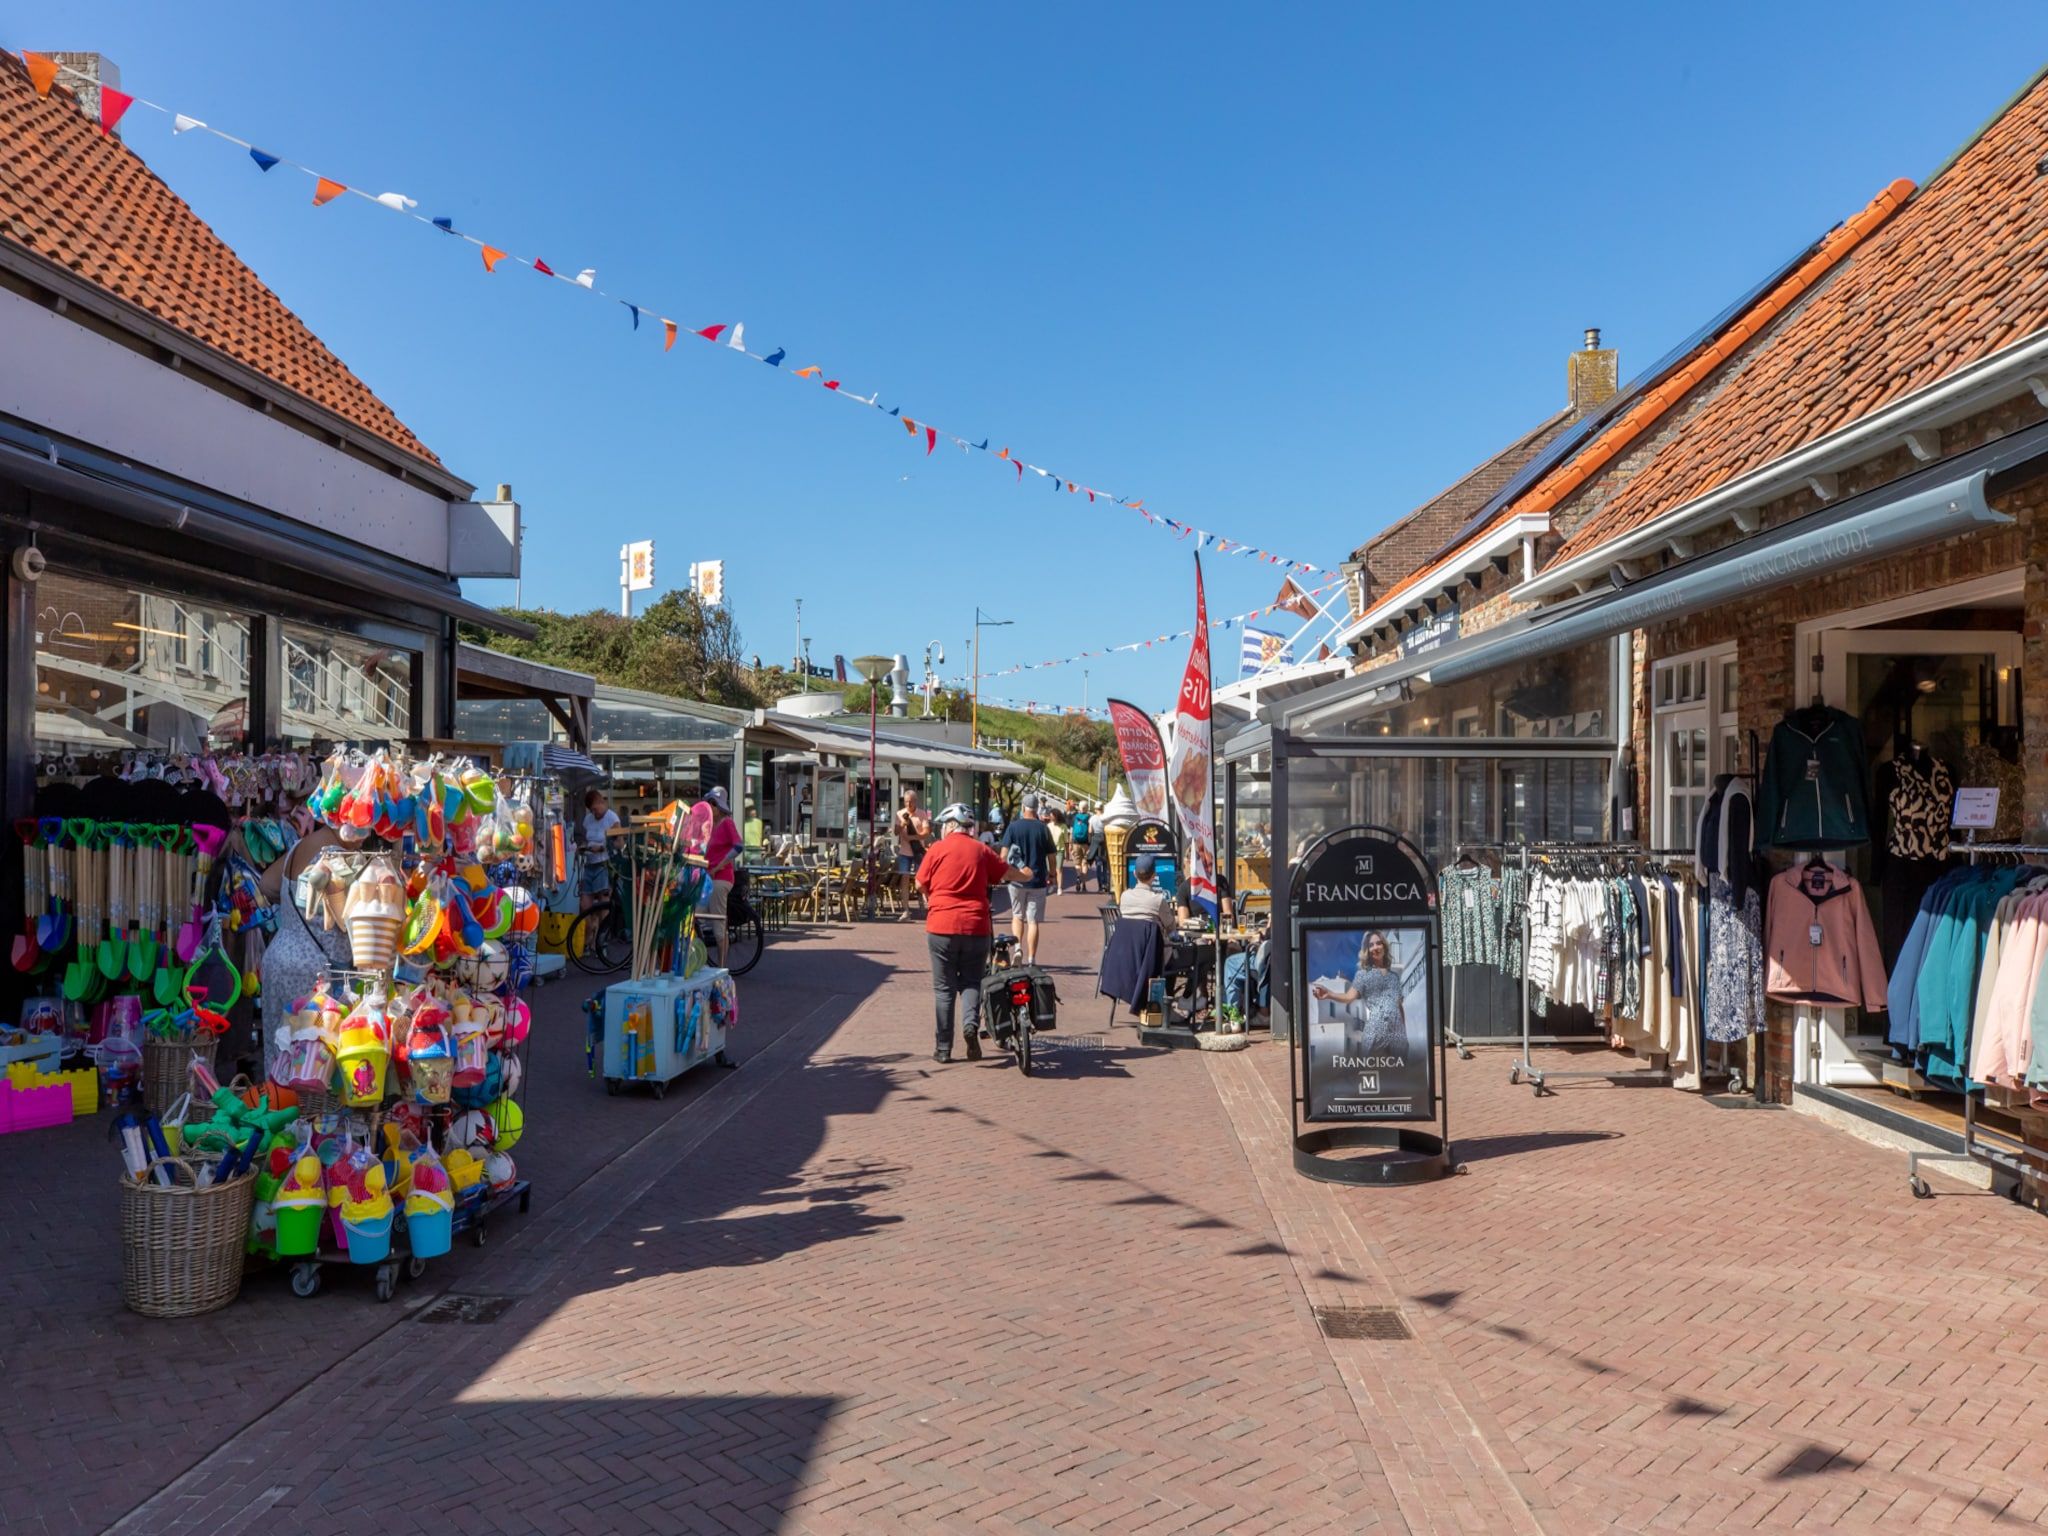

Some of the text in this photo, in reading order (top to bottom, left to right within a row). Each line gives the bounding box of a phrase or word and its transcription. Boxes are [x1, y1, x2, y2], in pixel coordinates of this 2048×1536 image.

[1740, 525, 1874, 587] FRANCISCA MODE
[1358, 859, 1370, 871] M
[1305, 882, 1422, 902] FRANCISCA
[1332, 1055, 1405, 1068] FRANCISCA
[1362, 1075, 1376, 1090] M
[1327, 1103, 1412, 1114] NIEUWE COLLECTIE
